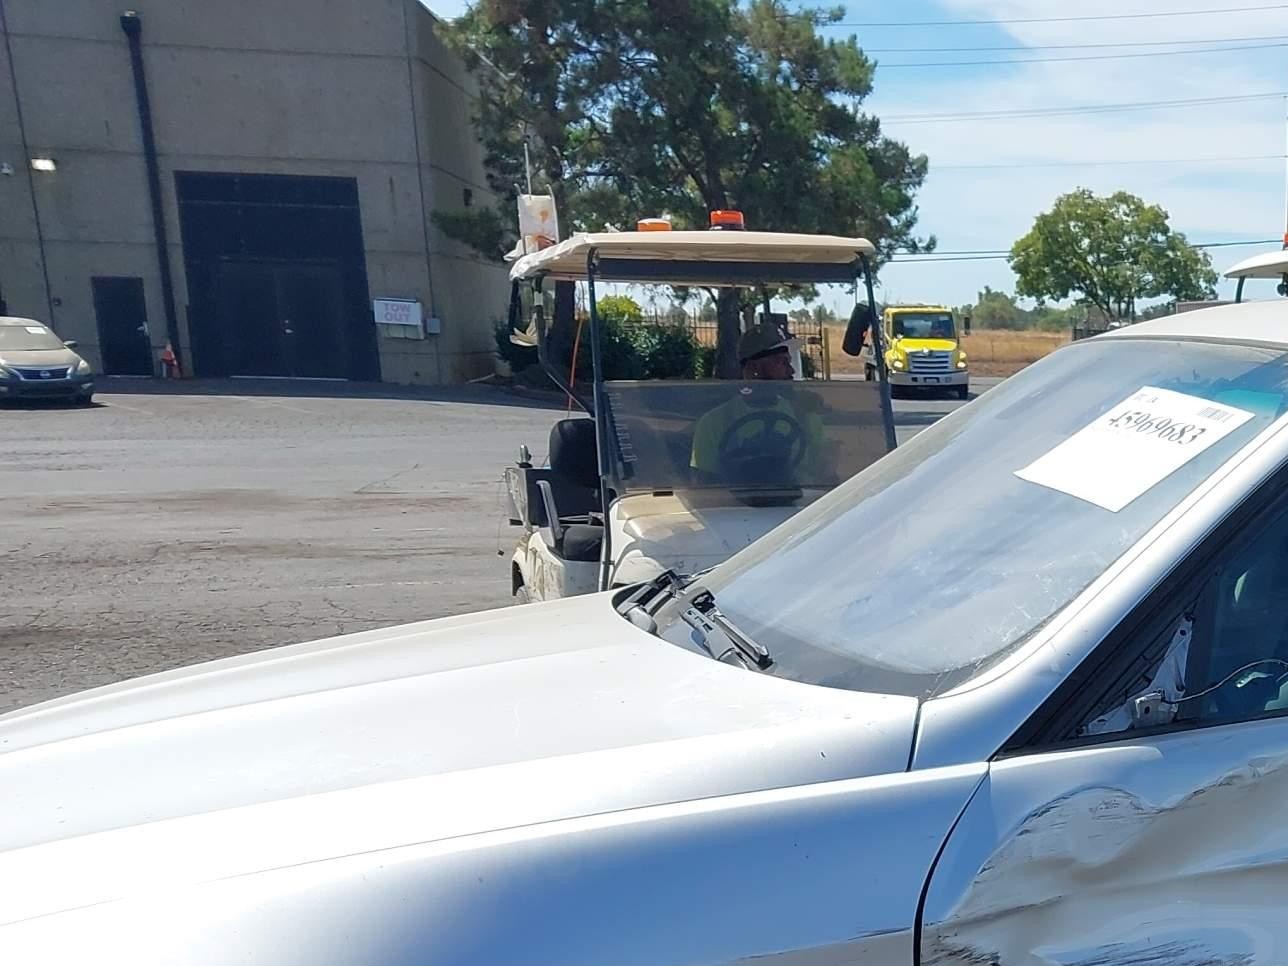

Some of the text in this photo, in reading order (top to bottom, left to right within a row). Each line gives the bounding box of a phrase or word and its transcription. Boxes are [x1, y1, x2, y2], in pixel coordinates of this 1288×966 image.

[384, 303, 411, 312] TOW
[384, 312, 409, 321] OUT
[1109, 410, 1207, 444] 45969683
